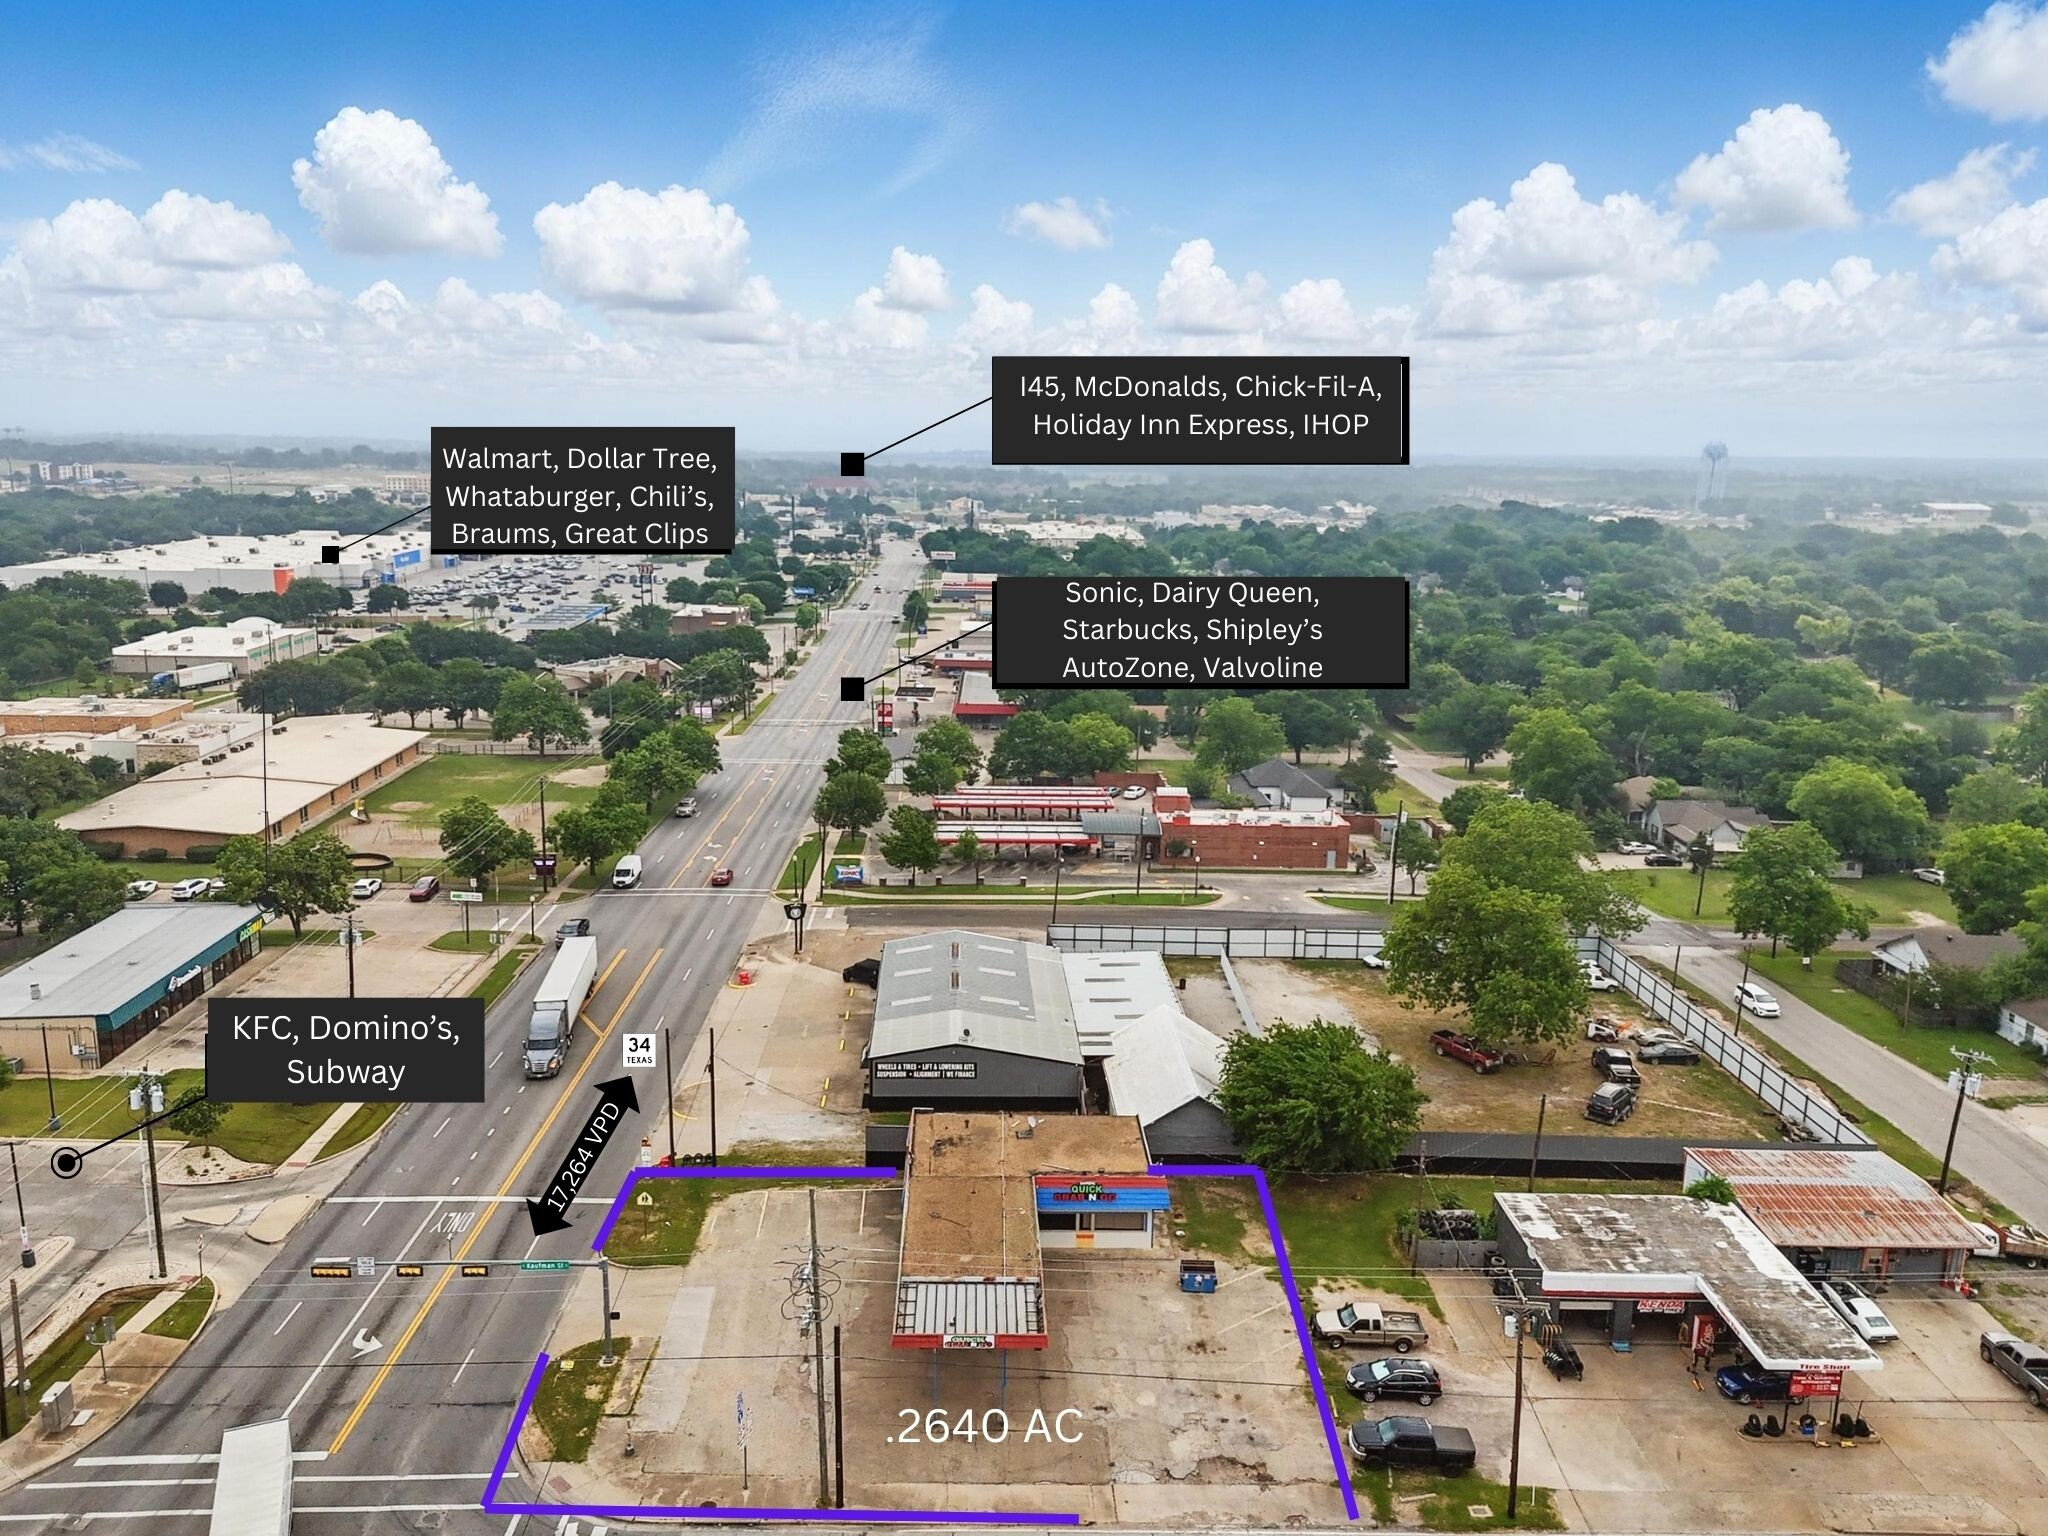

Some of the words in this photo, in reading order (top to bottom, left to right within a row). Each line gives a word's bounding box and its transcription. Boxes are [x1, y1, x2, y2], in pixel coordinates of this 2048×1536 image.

[1071, 1185, 1103, 1193] QUICK
[1054, 1193, 1085, 1201] GRAB
[1100, 1193, 1118, 1201] GO
[429, 1212, 475, 1232] ONLY
[1639, 1299, 1684, 1309] KENDA
